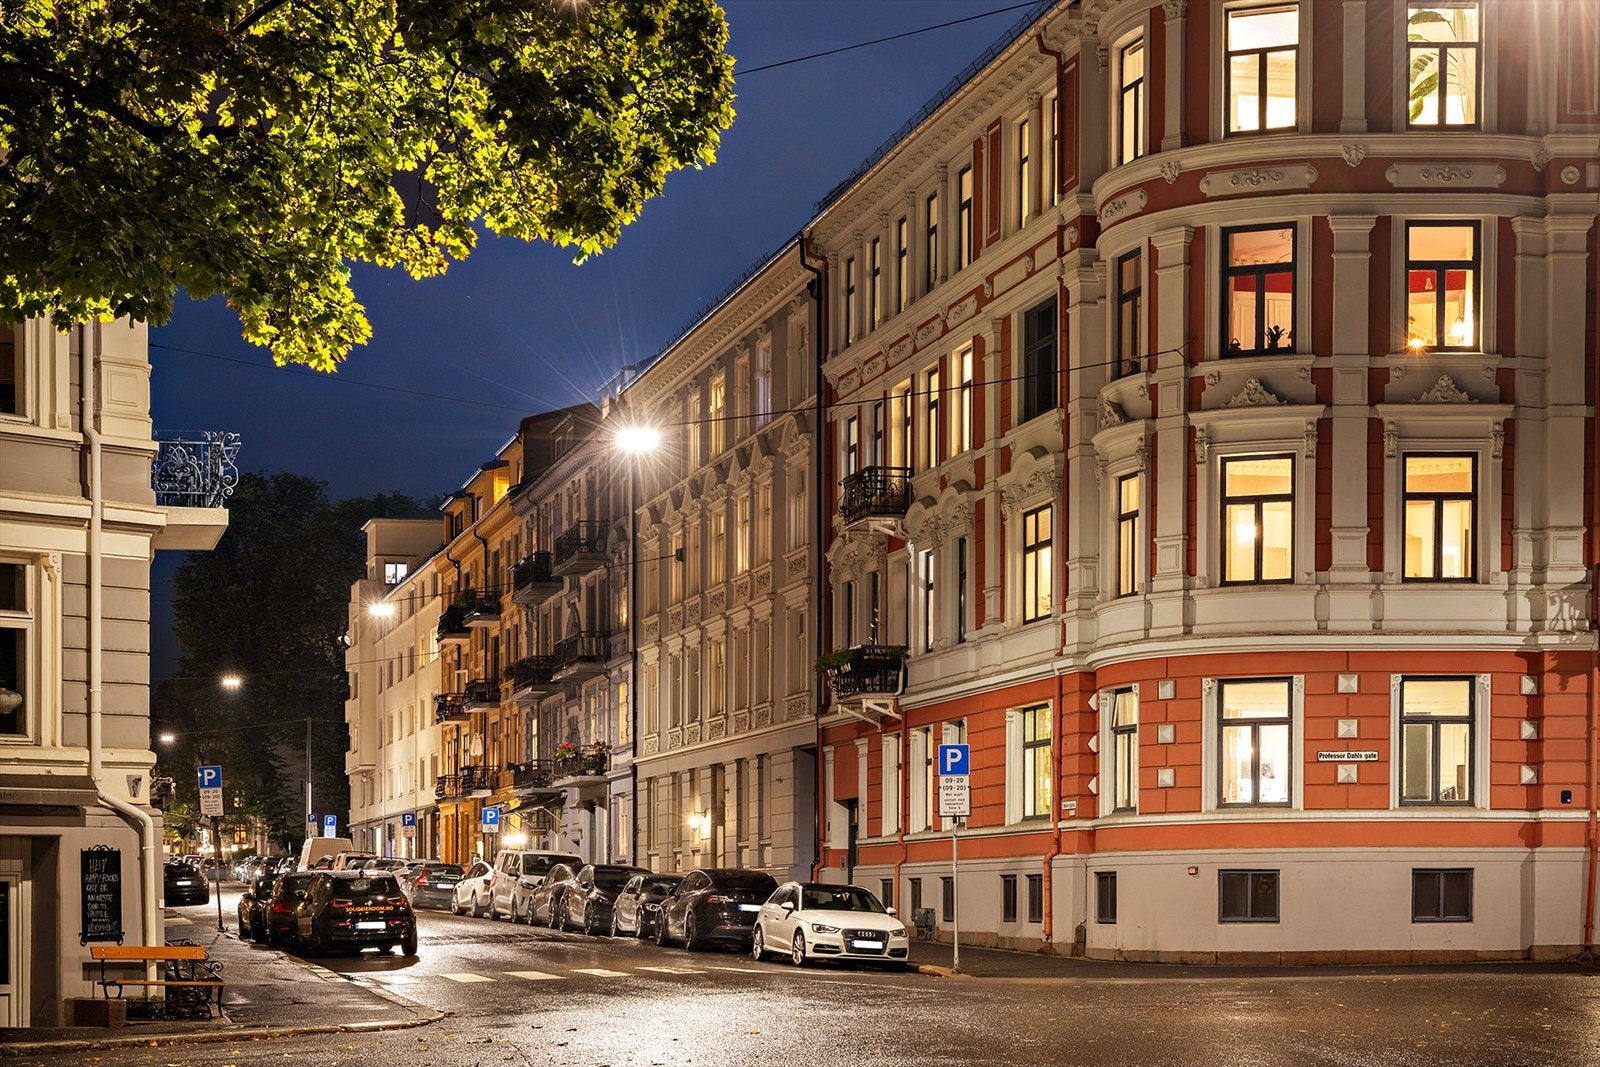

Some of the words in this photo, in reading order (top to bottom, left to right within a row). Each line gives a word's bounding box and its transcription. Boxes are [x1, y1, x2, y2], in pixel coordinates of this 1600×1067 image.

[946, 748, 962, 772] P
[203, 769, 216, 786] P
[327, 816, 334, 825] P
[405, 814, 413, 825] P
[487, 811, 496, 823] P
